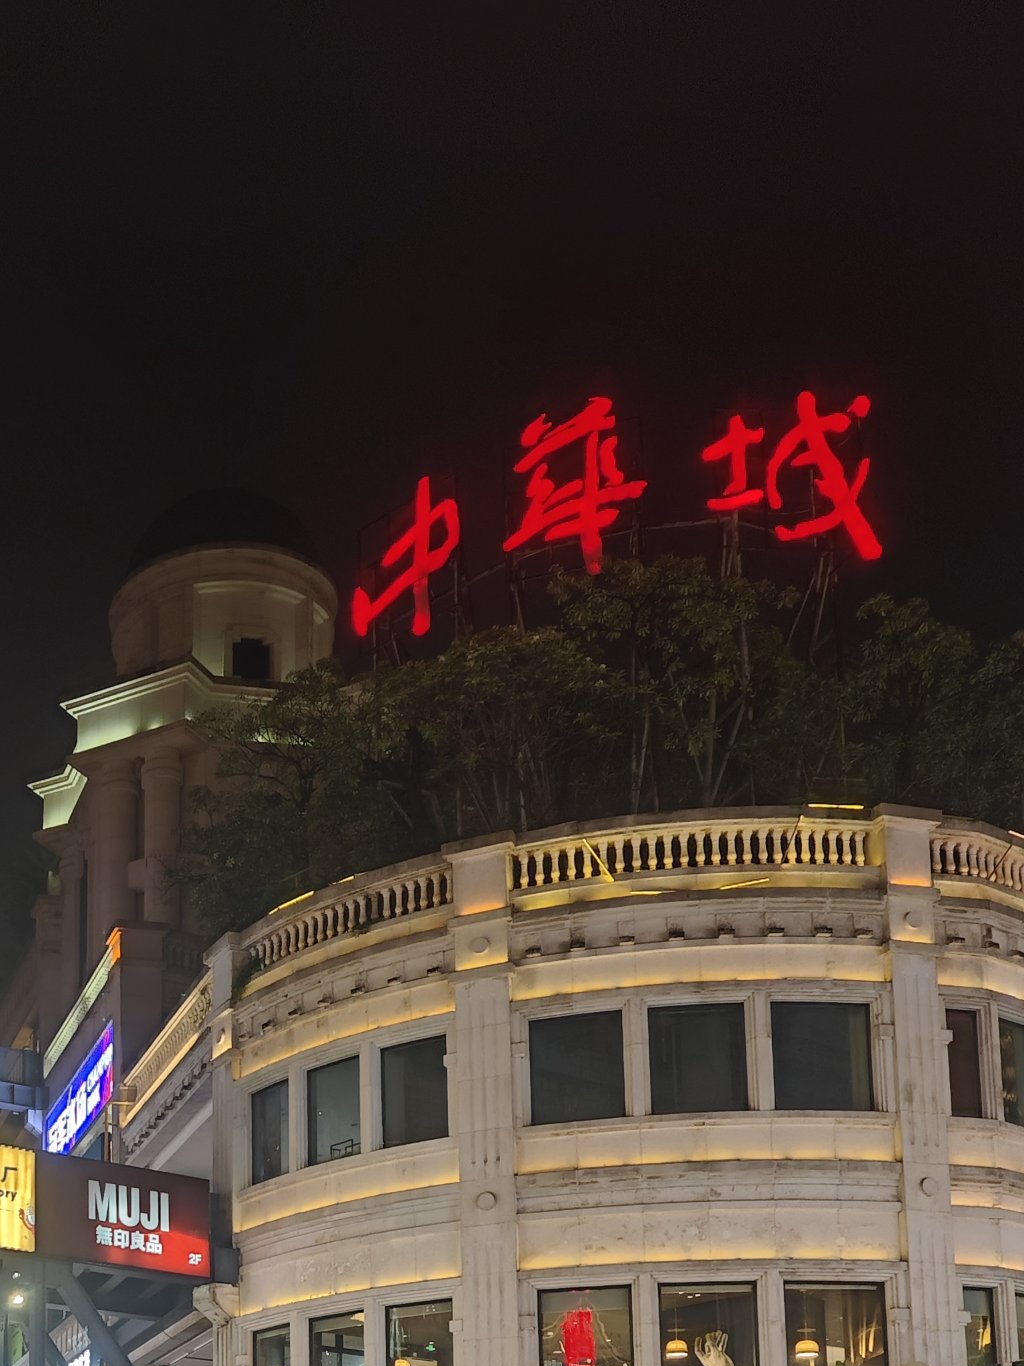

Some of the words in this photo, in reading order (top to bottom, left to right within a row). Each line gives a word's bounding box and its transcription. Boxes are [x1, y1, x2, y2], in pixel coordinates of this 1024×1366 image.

[87, 1179, 170, 1233] MUJI
[95, 1224, 163, 1255] 無印良品
[188, 1253, 203, 1265] 2F
